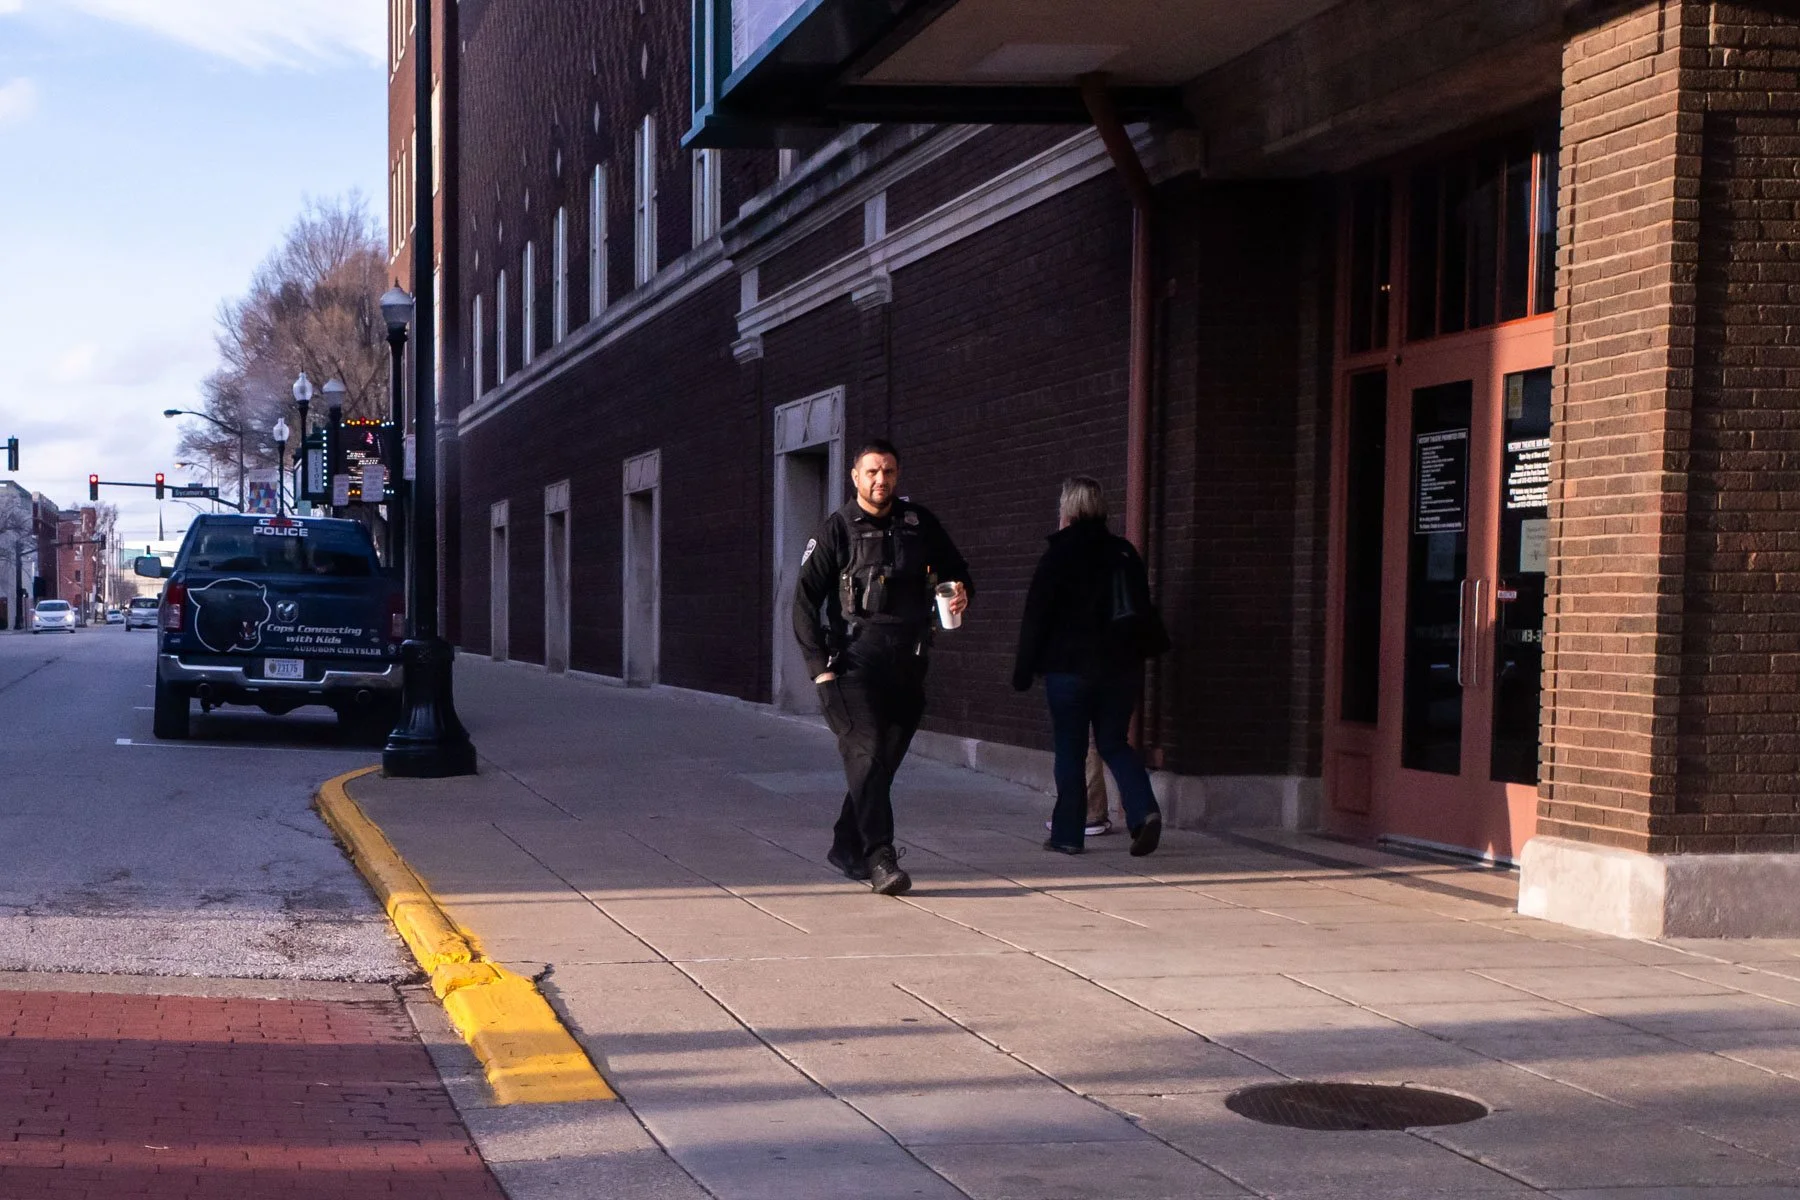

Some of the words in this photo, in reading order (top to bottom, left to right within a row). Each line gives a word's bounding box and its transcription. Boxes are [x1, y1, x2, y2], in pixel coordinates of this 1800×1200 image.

[253, 526, 308, 536] POLICE
[266, 623, 295, 633] Cops
[297, 625, 362, 636] Connecting
[286, 635, 313, 643] with
[315, 636, 342, 644] Kids
[293, 646, 335, 654] AUDUBON
[337, 648, 382, 656] CHRYSLER
